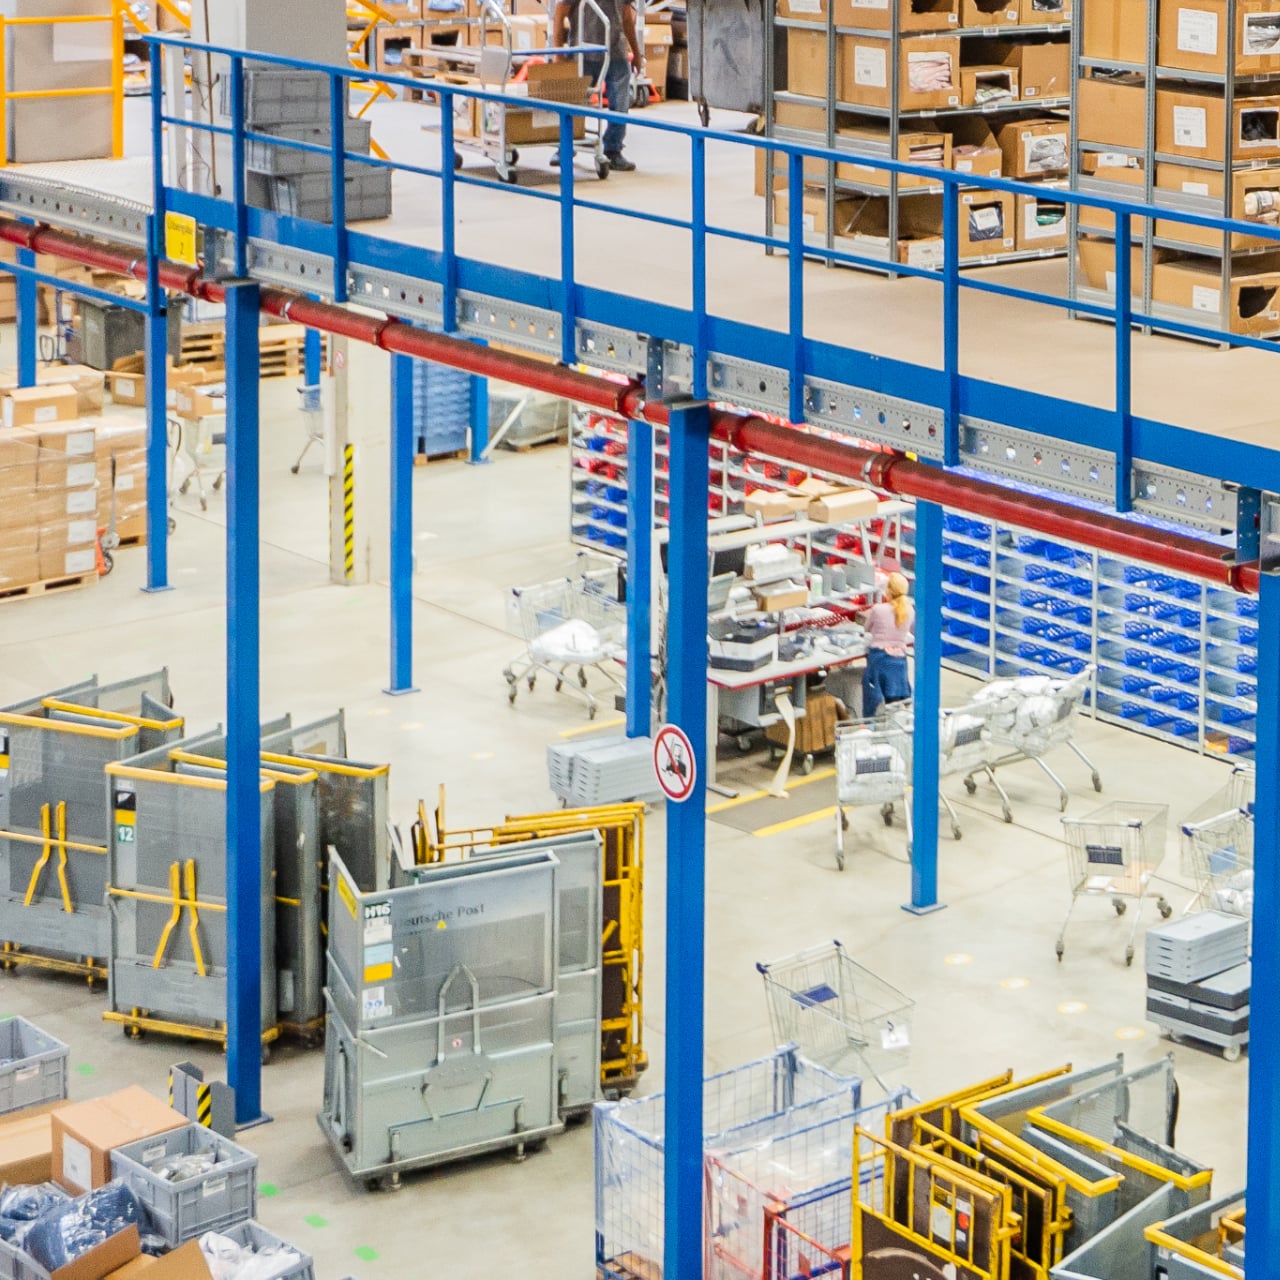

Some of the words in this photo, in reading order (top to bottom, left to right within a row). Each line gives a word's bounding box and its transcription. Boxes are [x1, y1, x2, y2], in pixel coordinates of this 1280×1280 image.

[119, 826, 133, 842] 12
[365, 903, 391, 918] H16
[457, 903, 485, 918] Post
